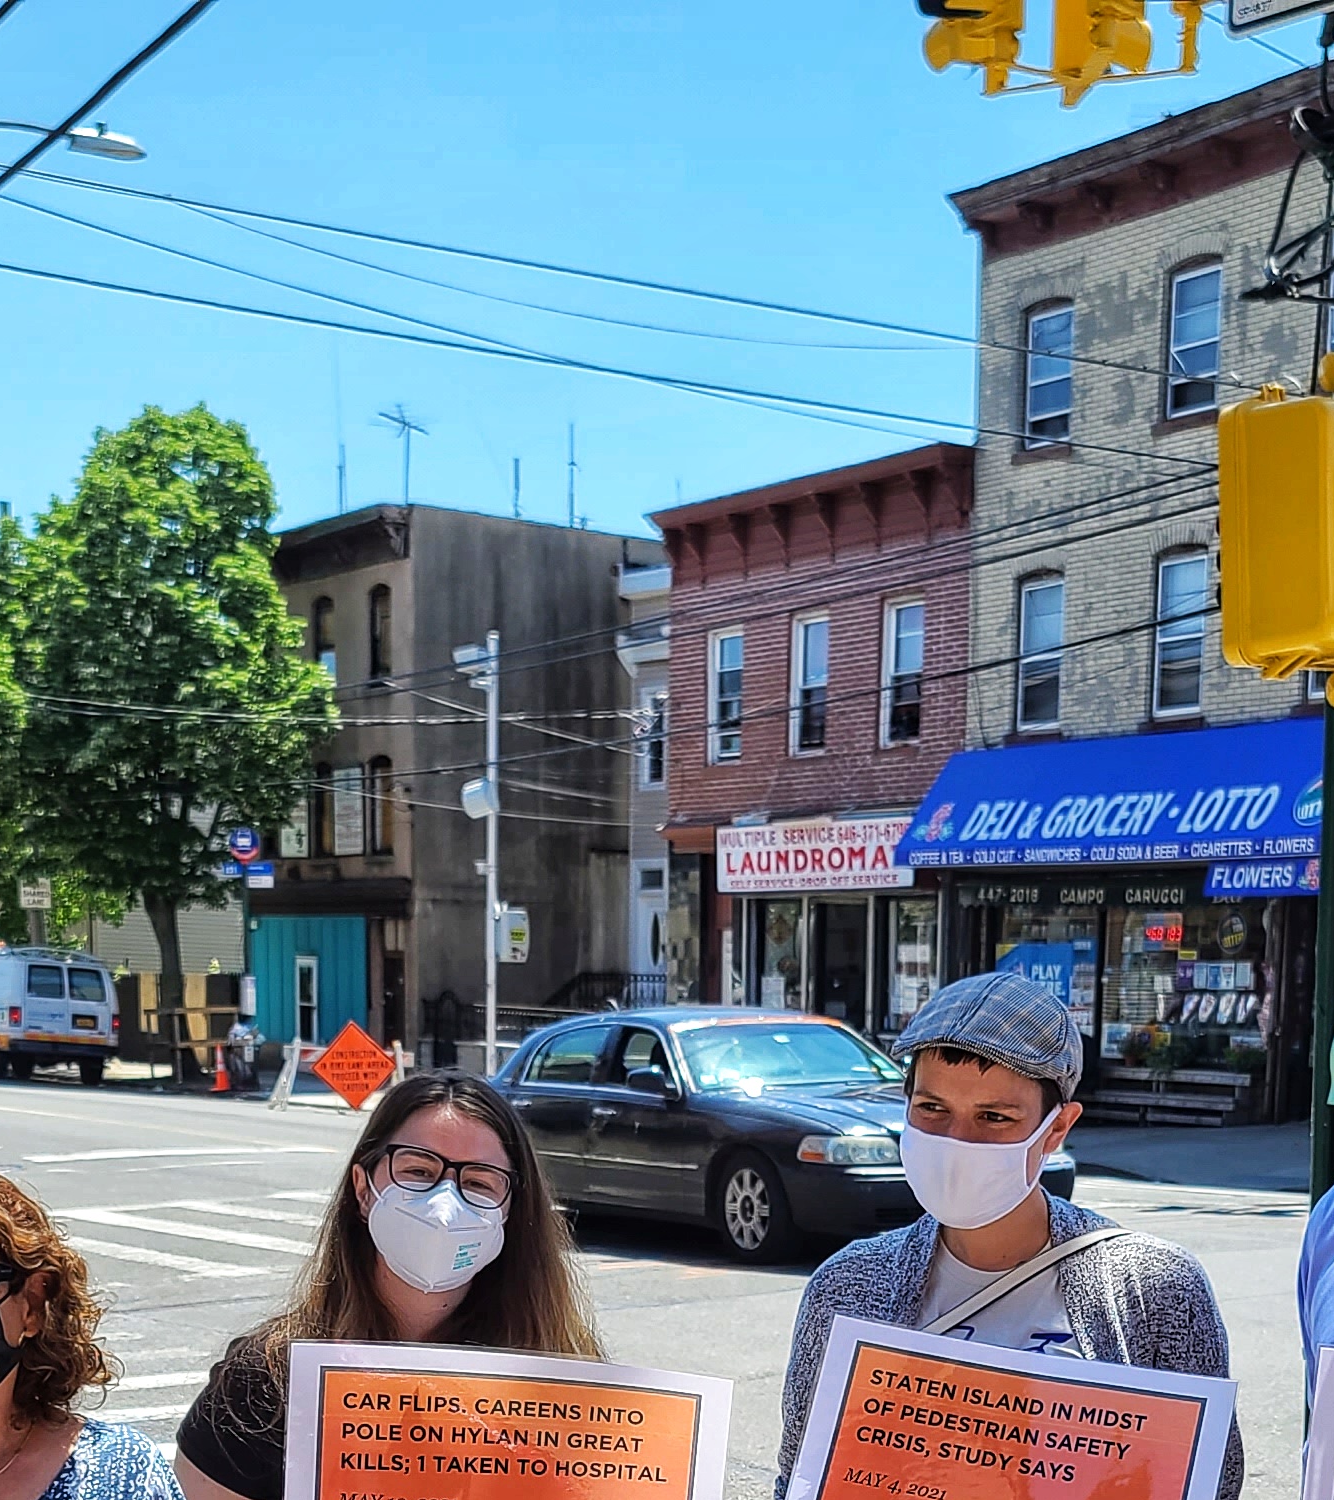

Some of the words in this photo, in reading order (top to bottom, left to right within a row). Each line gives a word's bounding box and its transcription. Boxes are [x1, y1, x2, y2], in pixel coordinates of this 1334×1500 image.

[959, 800, 1029, 841] DELI
[1017, 806, 1044, 840] &
[1040, 789, 1176, 839] GROCERY
[1176, 785, 1281, 834] LOTTO
[719, 829, 777, 849] MULTIPLE
[783, 826, 835, 846] SERVICE
[909, 850, 940, 865] COFFEE
[940, 851, 948, 864] &
[948, 850, 964, 864] TEA
[973, 850, 996, 863] COLD
[997, 849, 1016, 863] CUT
[1023, 847, 1081, 862] SANDWICHES
[1090, 846, 1115, 861] COLD
[1116, 845, 1143, 860] SODA
[1143, 845, 1152, 859] &
[1153, 844, 1179, 859] BEER
[1190, 841, 1253, 857] CIGARETTES
[1262, 838, 1315, 855] FLOWERS
[730, 879, 753, 890] SELF
[830, 876, 851, 887] OFF
[852, 873, 900, 886] SERVICE
[1211, 865, 1294, 890] FLOWERS
[1031, 964, 1062, 981] PLAY
[343, 1393, 391, 1411] CAR
[474, 1398, 581, 1421] CAREENS
[589, 1406, 644, 1425] INTO
[870, 1369, 956, 1400] STATEN
[962, 1387, 1045, 1416] ISLAND
[1050, 1403, 1073, 1421] IN
[1079, 1407, 1148, 1432] MIDST
[342, 1423, 403, 1442] POLE
[409, 1424, 443, 1443] ON
[450, 1426, 529, 1447] HYLAN
[537, 1431, 560, 1448] IN
[567, 1433, 644, 1453] GREAT
[863, 1398, 895, 1420] OF
[900, 1404, 1040, 1446] PEDESTRIAN
[1045, 1432, 1131, 1461] SAFETY
[340, 1452, 411, 1475] KILLS;
[417, 1455, 425, 1472] 1
[432, 1455, 510, 1475] TAKEN
[516, 1458, 548, 1477] TO
[554, 1459, 667, 1483] HOSPITAL
[856, 1426, 931, 1458] CRISIS,
[938, 1442, 1014, 1472] STUDY
[1018, 1457, 1076, 1483] SAYS
[842, 1467, 886, 1490] MAY
[888, 1475, 903, 1496] 4,
